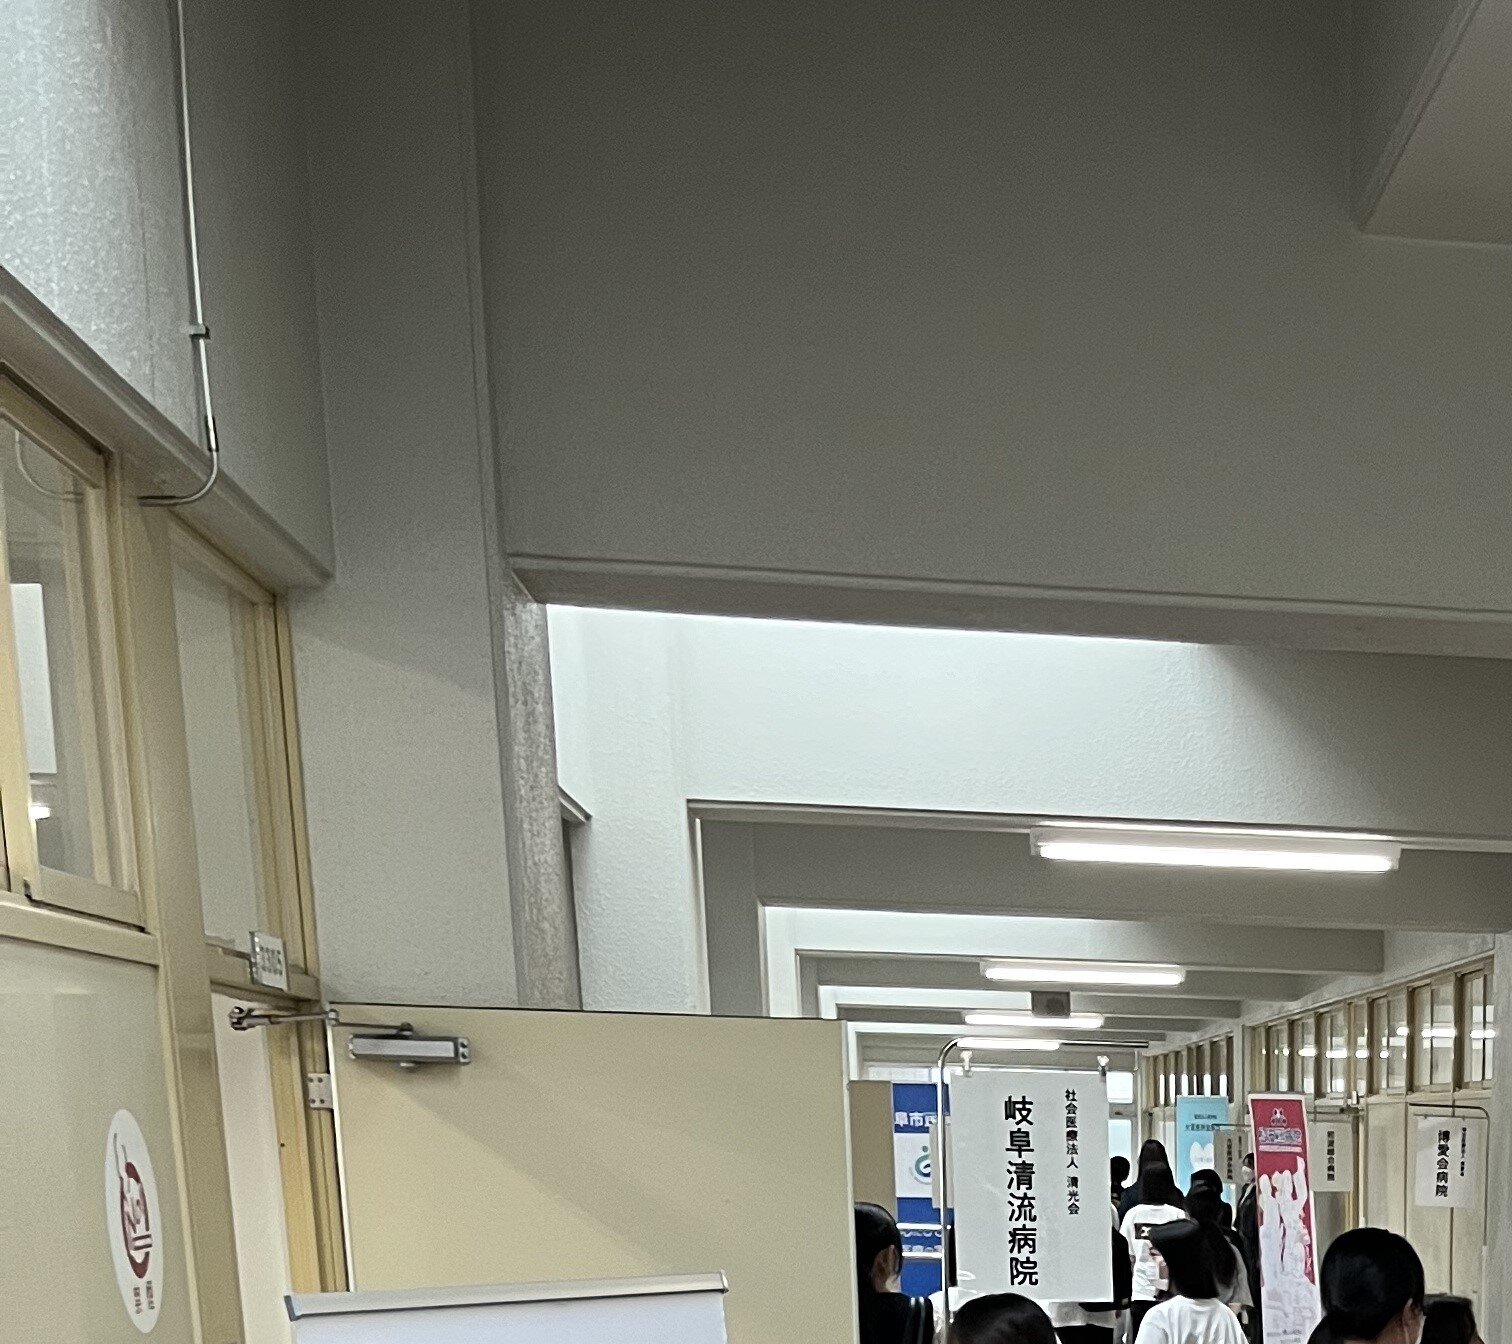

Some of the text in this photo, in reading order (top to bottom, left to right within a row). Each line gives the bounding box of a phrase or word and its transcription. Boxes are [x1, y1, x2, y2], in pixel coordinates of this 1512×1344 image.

[1004, 1095, 1039, 1286] 岐阜清流病院
[1065, 1088, 1080, 1215] 社会医療法人 清光会
